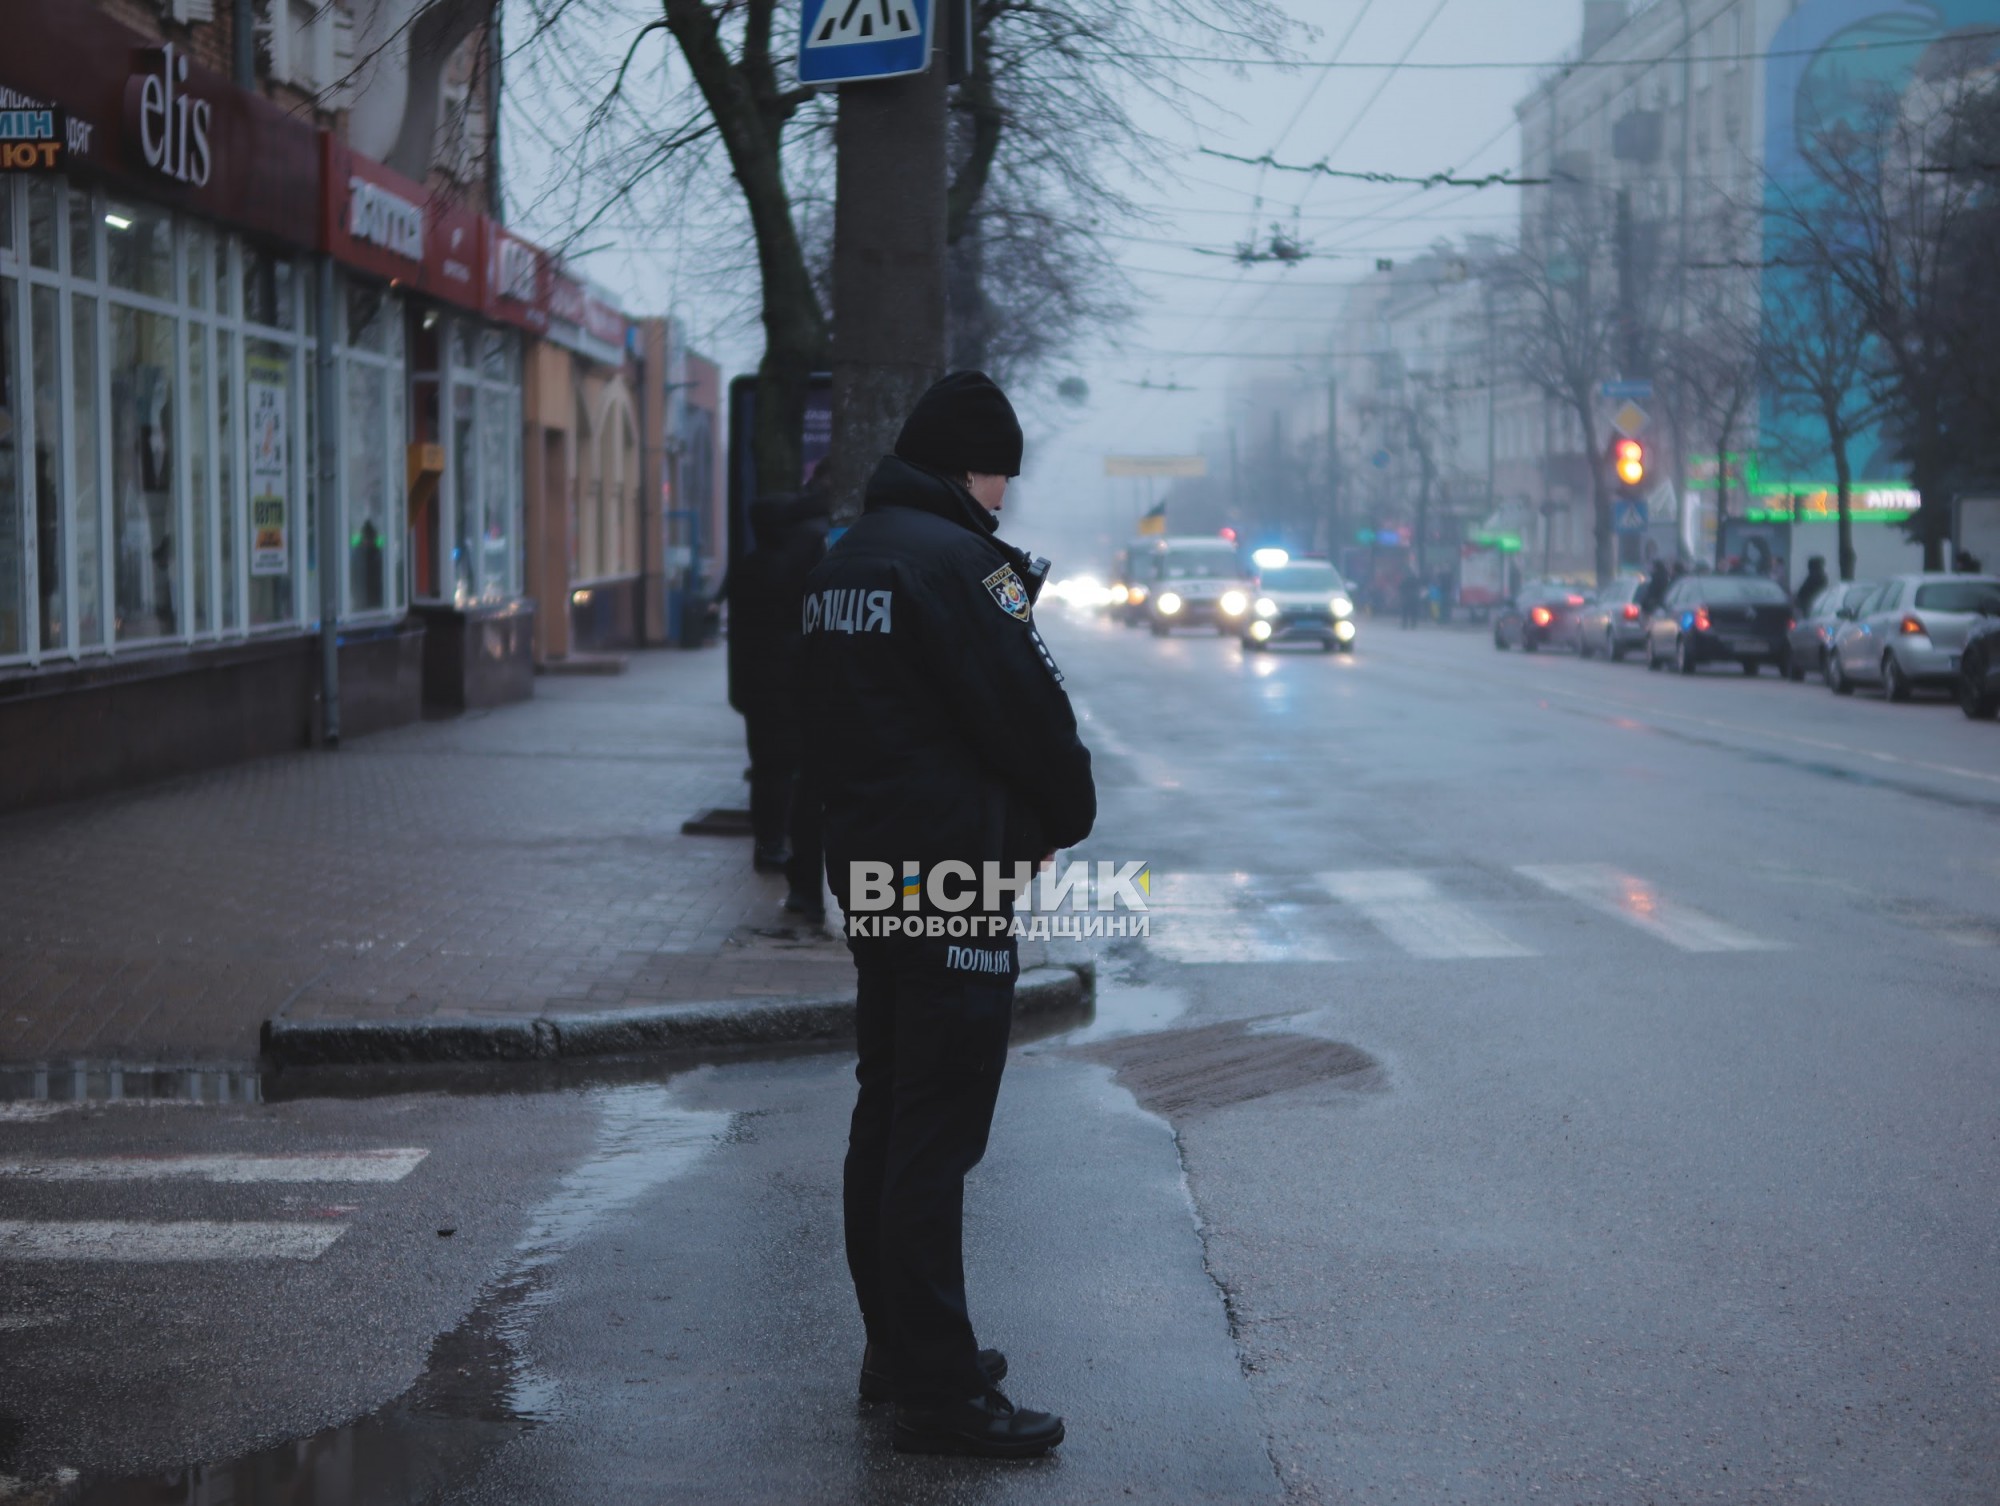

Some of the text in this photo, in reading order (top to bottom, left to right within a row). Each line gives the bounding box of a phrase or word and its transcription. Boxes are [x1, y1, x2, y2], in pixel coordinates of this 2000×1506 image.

[141, 42, 211, 187] elis
[66, 116, 92, 155] ДЯГ
[946, 945, 1010, 975] ПОЛІЦІЯ
